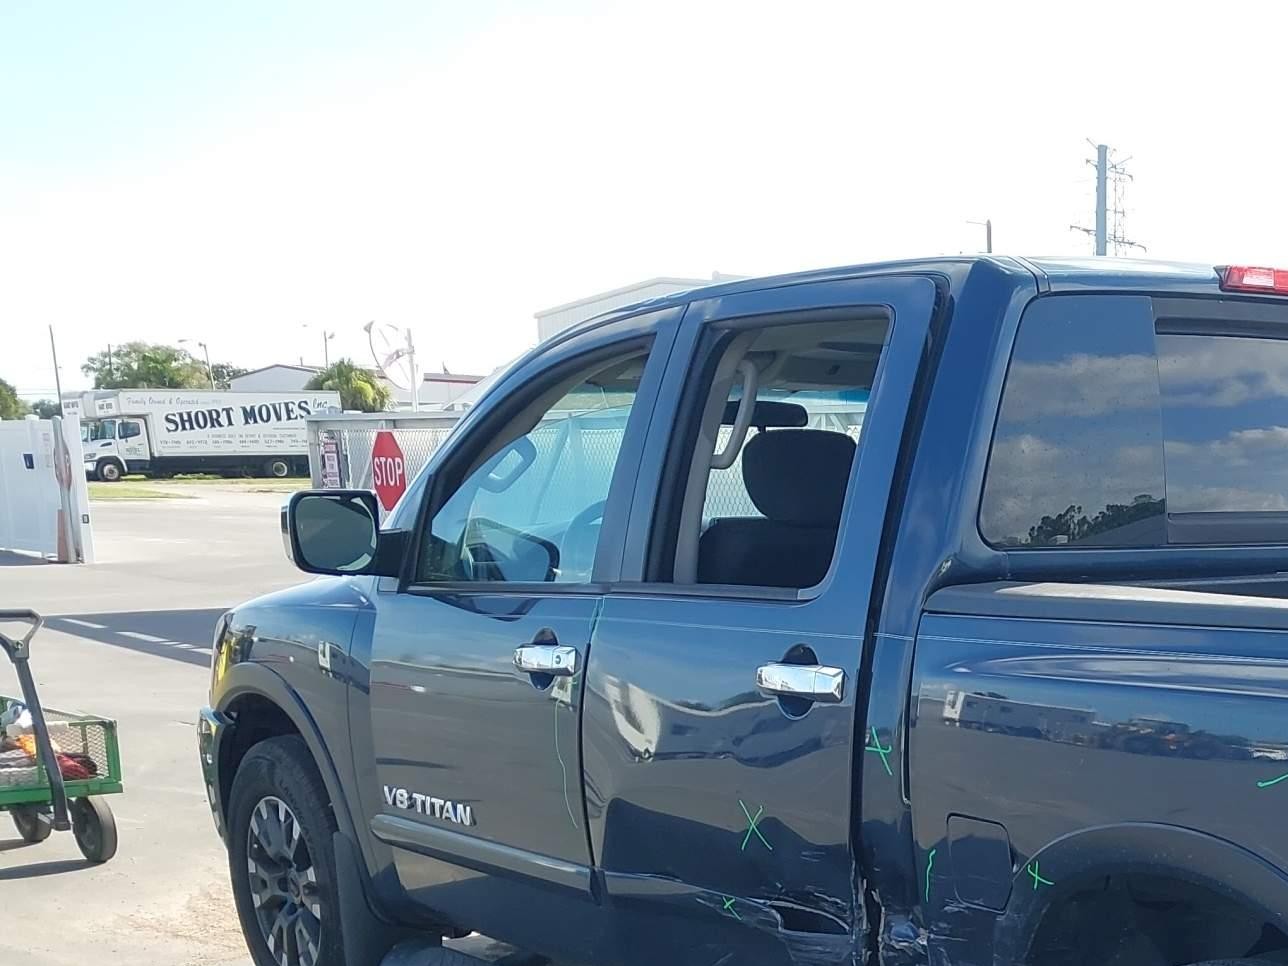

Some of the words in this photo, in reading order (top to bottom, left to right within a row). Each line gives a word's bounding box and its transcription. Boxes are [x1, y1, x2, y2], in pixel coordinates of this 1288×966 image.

[164, 407, 235, 433] SHORT
[240, 400, 311, 426] MOVES
[374, 456, 403, 487] STOP
[383, 785, 409, 809] V8
[412, 793, 472, 827] TITAN
